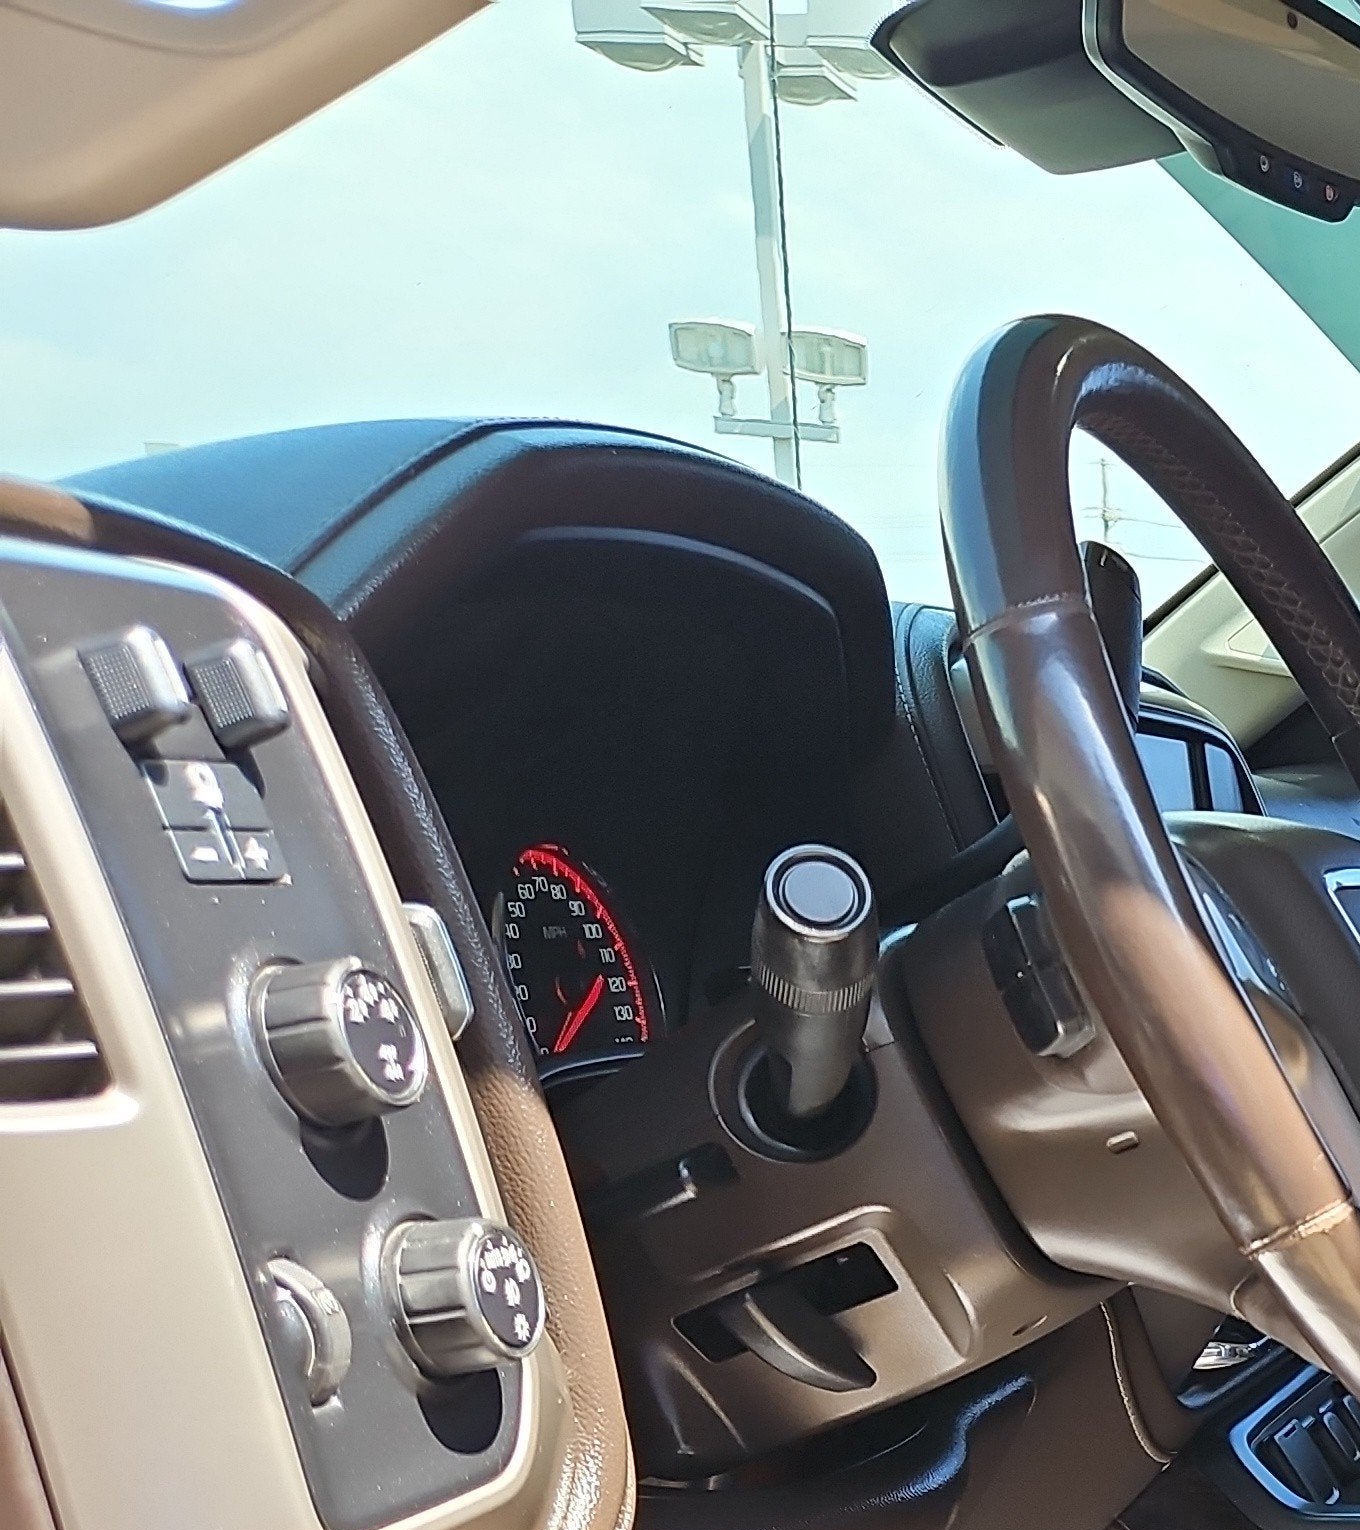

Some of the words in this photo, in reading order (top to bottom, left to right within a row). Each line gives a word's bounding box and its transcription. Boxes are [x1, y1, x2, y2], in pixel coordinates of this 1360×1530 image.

[518, 884, 535, 900] 60
[532, 876, 548, 892] 70
[550, 884, 567, 900] 80
[507, 902, 526, 918] 50
[568, 900, 585, 917] 90
[582, 923, 603, 939] 100
[599, 948, 616, 963] 110
[607, 977, 627, 993] 120
[614, 1005, 633, 1021] 130
